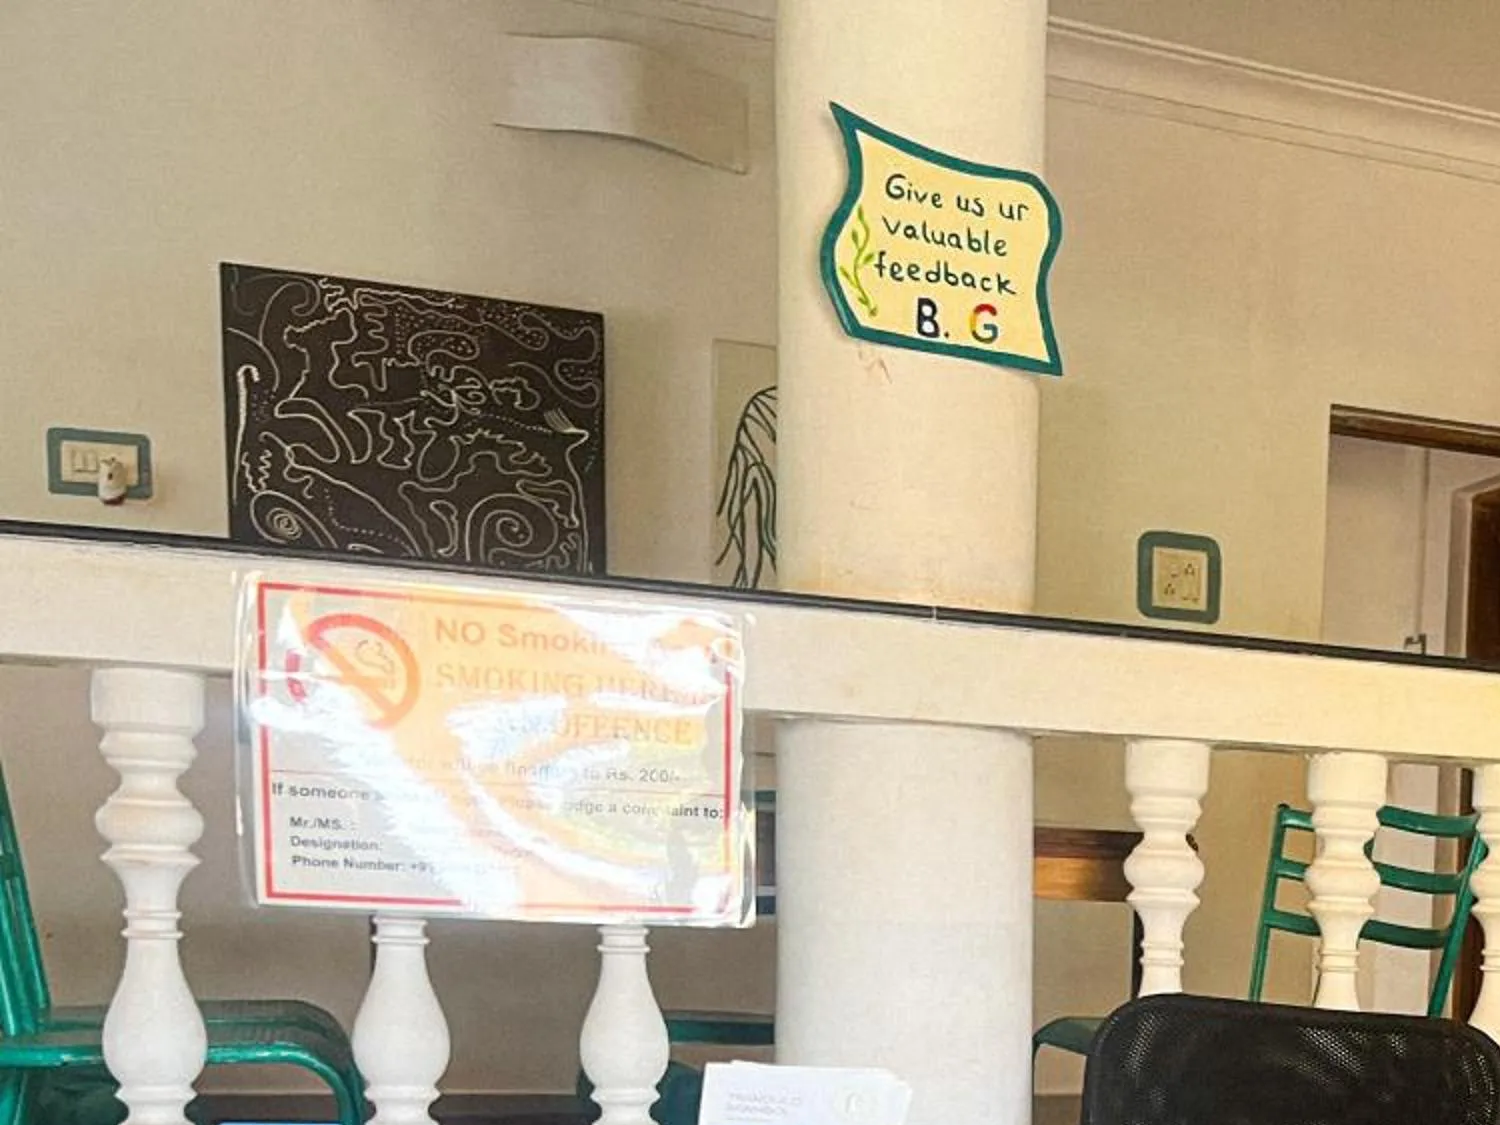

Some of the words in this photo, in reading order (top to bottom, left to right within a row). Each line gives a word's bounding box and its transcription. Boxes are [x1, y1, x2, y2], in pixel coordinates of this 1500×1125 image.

[885, 173, 943, 209] Give
[956, 194, 985, 217] us
[999, 202, 1030, 221] ur
[874, 251, 1016, 295] feedback
[435, 617, 486, 646] NO
[498, 622, 608, 657] Smoki
[436, 663, 584, 698] SMOKING
[271, 782, 283, 796] If
[289, 835, 384, 852] Designation:
[291, 855, 339, 869] Phone
[343, 857, 407, 873] Number:
